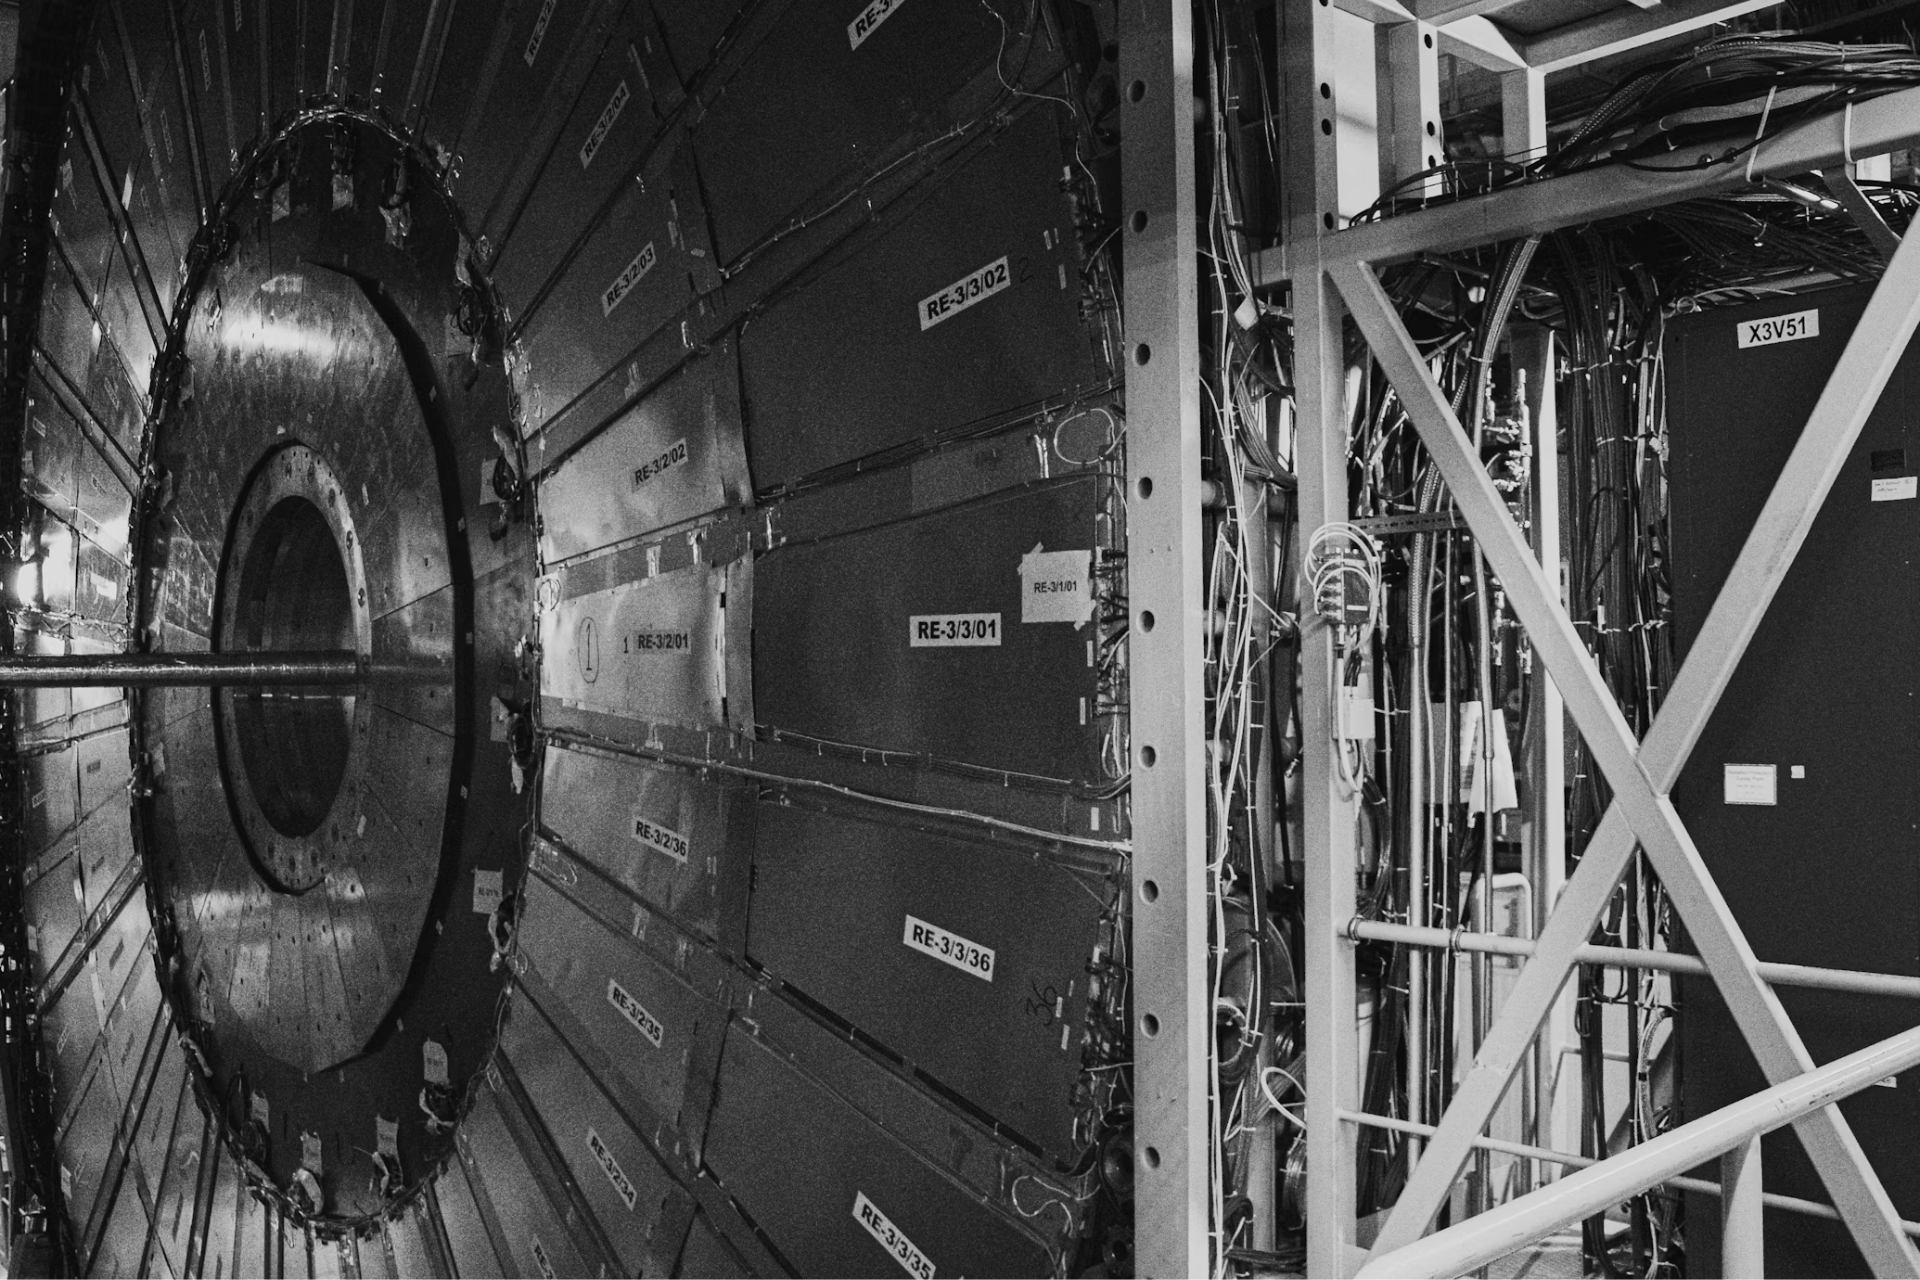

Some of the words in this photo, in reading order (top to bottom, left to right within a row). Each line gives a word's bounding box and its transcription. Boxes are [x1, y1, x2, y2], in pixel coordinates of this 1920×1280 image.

[585, 86, 626, 158] RE-3/2/04
[606, 248, 653, 307] RE-3/2/03
[927, 263, 1007, 320] RE-3/3/02
[1749, 316, 1806, 343] X3V51
[634, 443, 686, 486] RE-3/2/02
[1034, 581, 1077, 593] RE-3/1/01
[638, 633, 688, 650] RE-3/2/01
[918, 619, 996, 639] RE-3/3/01
[635, 820, 687, 857] RE-3/2/36
[912, 924, 991, 972] RE-3/3/36
[613, 986, 661, 1041] RE-3/2/35
[590, 1135, 634, 1203] RE-3/2/34
[861, 1203, 932, 1279] RE-3/3/35
